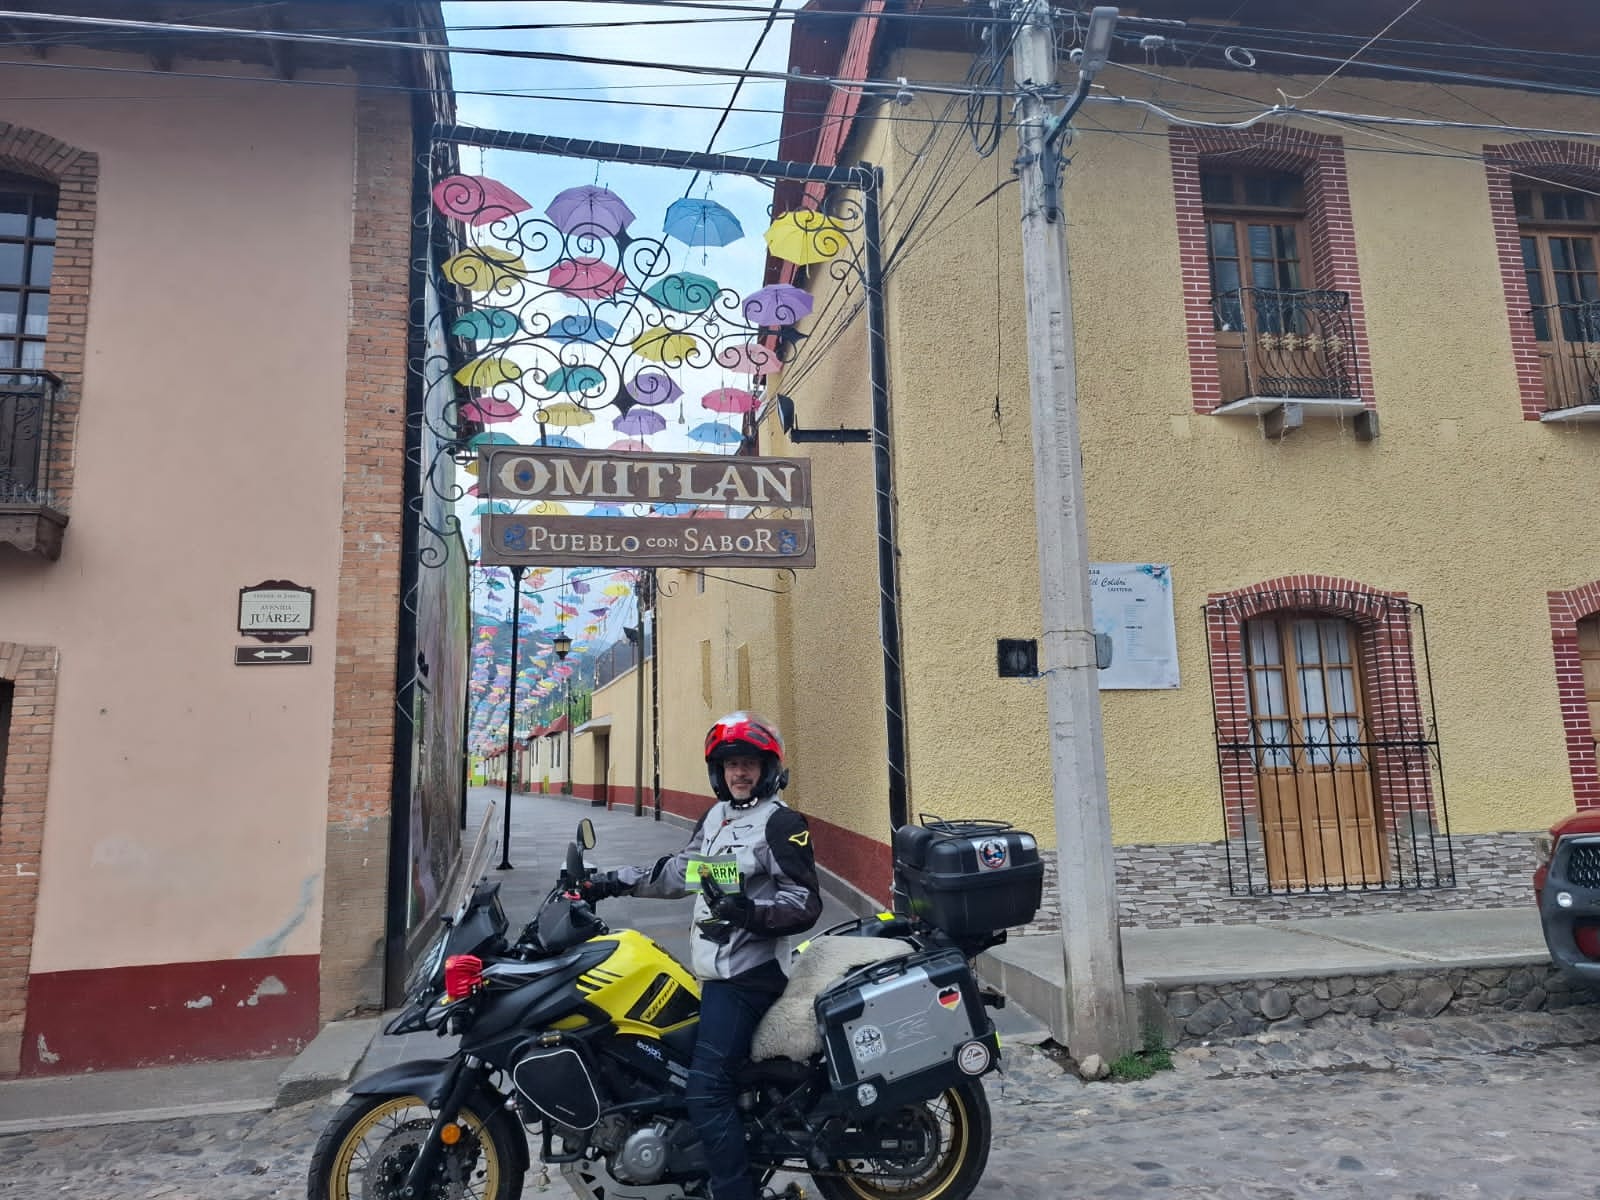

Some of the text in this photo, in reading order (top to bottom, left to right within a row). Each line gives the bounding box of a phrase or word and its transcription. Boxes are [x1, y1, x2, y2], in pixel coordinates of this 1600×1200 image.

[498, 456, 797, 502] OMITLAN
[528, 526, 640, 552] PUEBLO
[683, 528, 777, 552] SABOR
[248, 611, 301, 626] JUÁREZ
